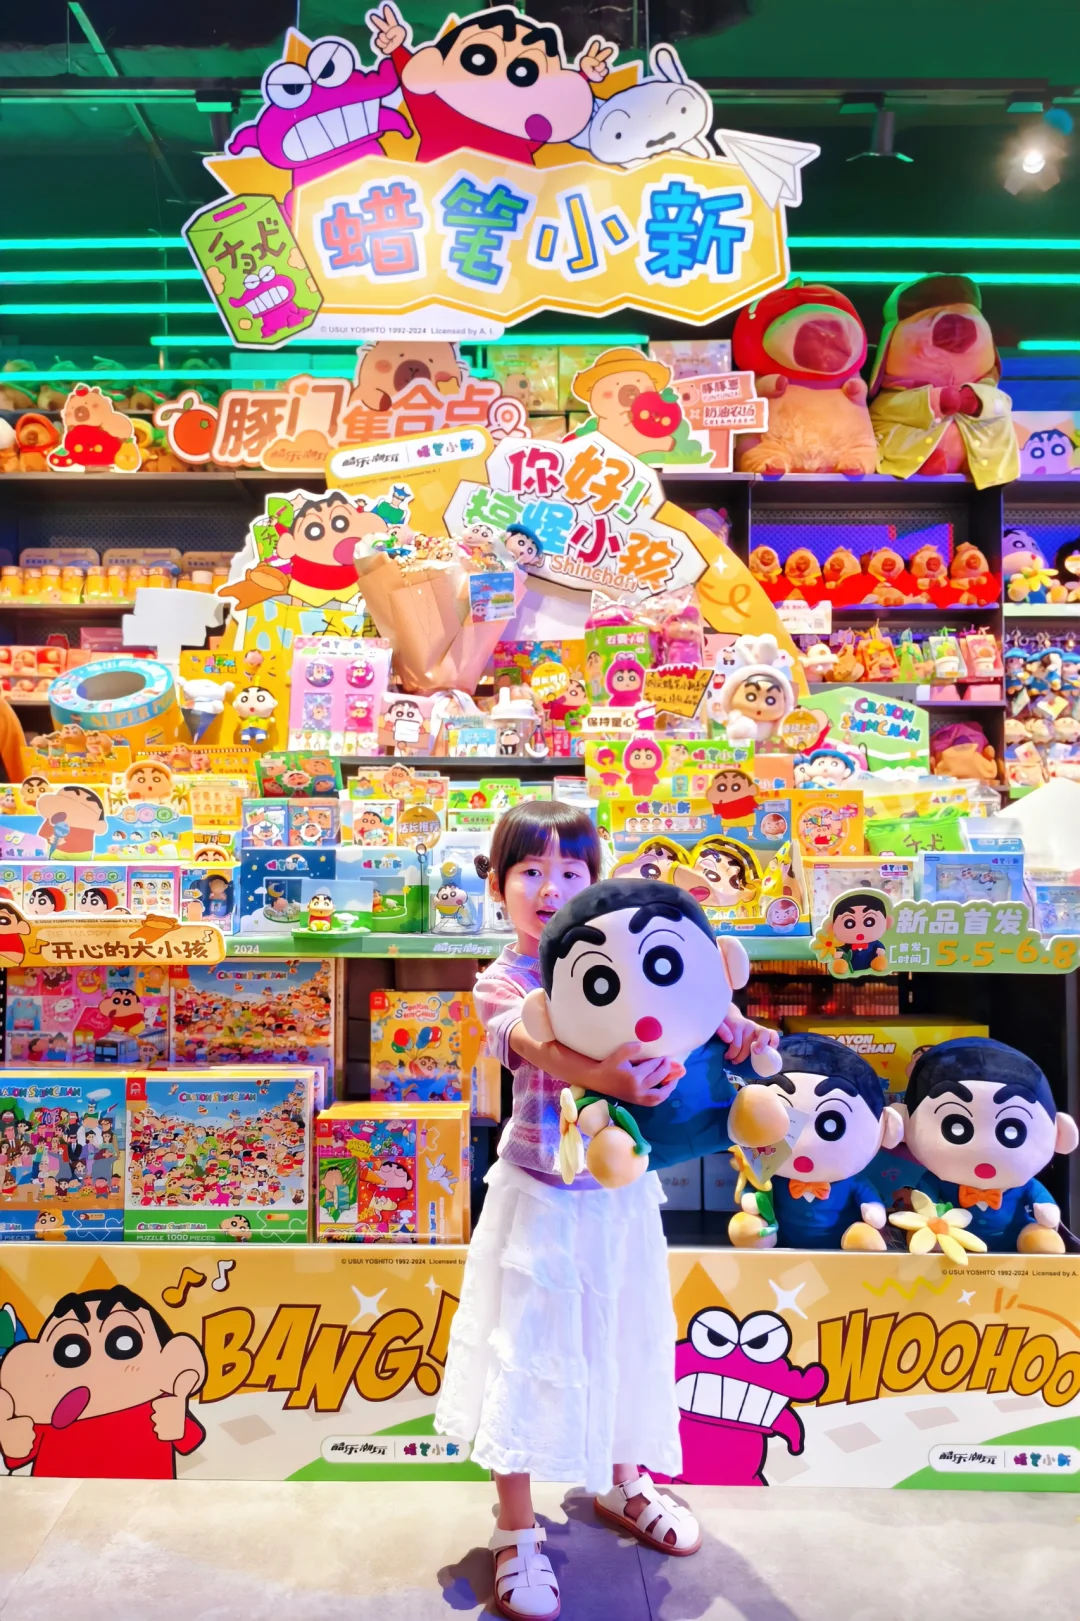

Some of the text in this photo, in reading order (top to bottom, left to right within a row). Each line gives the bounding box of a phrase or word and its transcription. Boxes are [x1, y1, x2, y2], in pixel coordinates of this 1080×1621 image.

[319, 175, 749, 285] 蜡笔小新
[430, 327, 466, 335] Licensed
[469, 328, 477, 336] by
[551, 554, 638, 592] Shinchan
[854, 696, 915, 724] CRAYON
[587, 717, 635, 728] 保持童心
[840, 713, 921, 742] SHINCHAN
[895, 907, 1024, 936] 新品首发
[50, 940, 209, 960] 开心的大小孩
[233, 944, 260, 955] 2024
[899, 942, 922, 953] 首发
[935, 936, 1078, 970] 5.5-6.8
[897, 954, 922, 964] 时间
[166, 1233, 189, 1241] 1000
[997, 1269, 1029, 1277] 1992-2024
[1032, 1269, 1061, 1277] Licensed
[1062, 1270, 1070, 1278] by
[199, 1289, 460, 1413] BANG!
[816, 1308, 1080, 1407] WOOHOO
[330, 1441, 388, 1456] 酷乐潮玩
[938, 1450, 998, 1465] 酷乐潮玩
